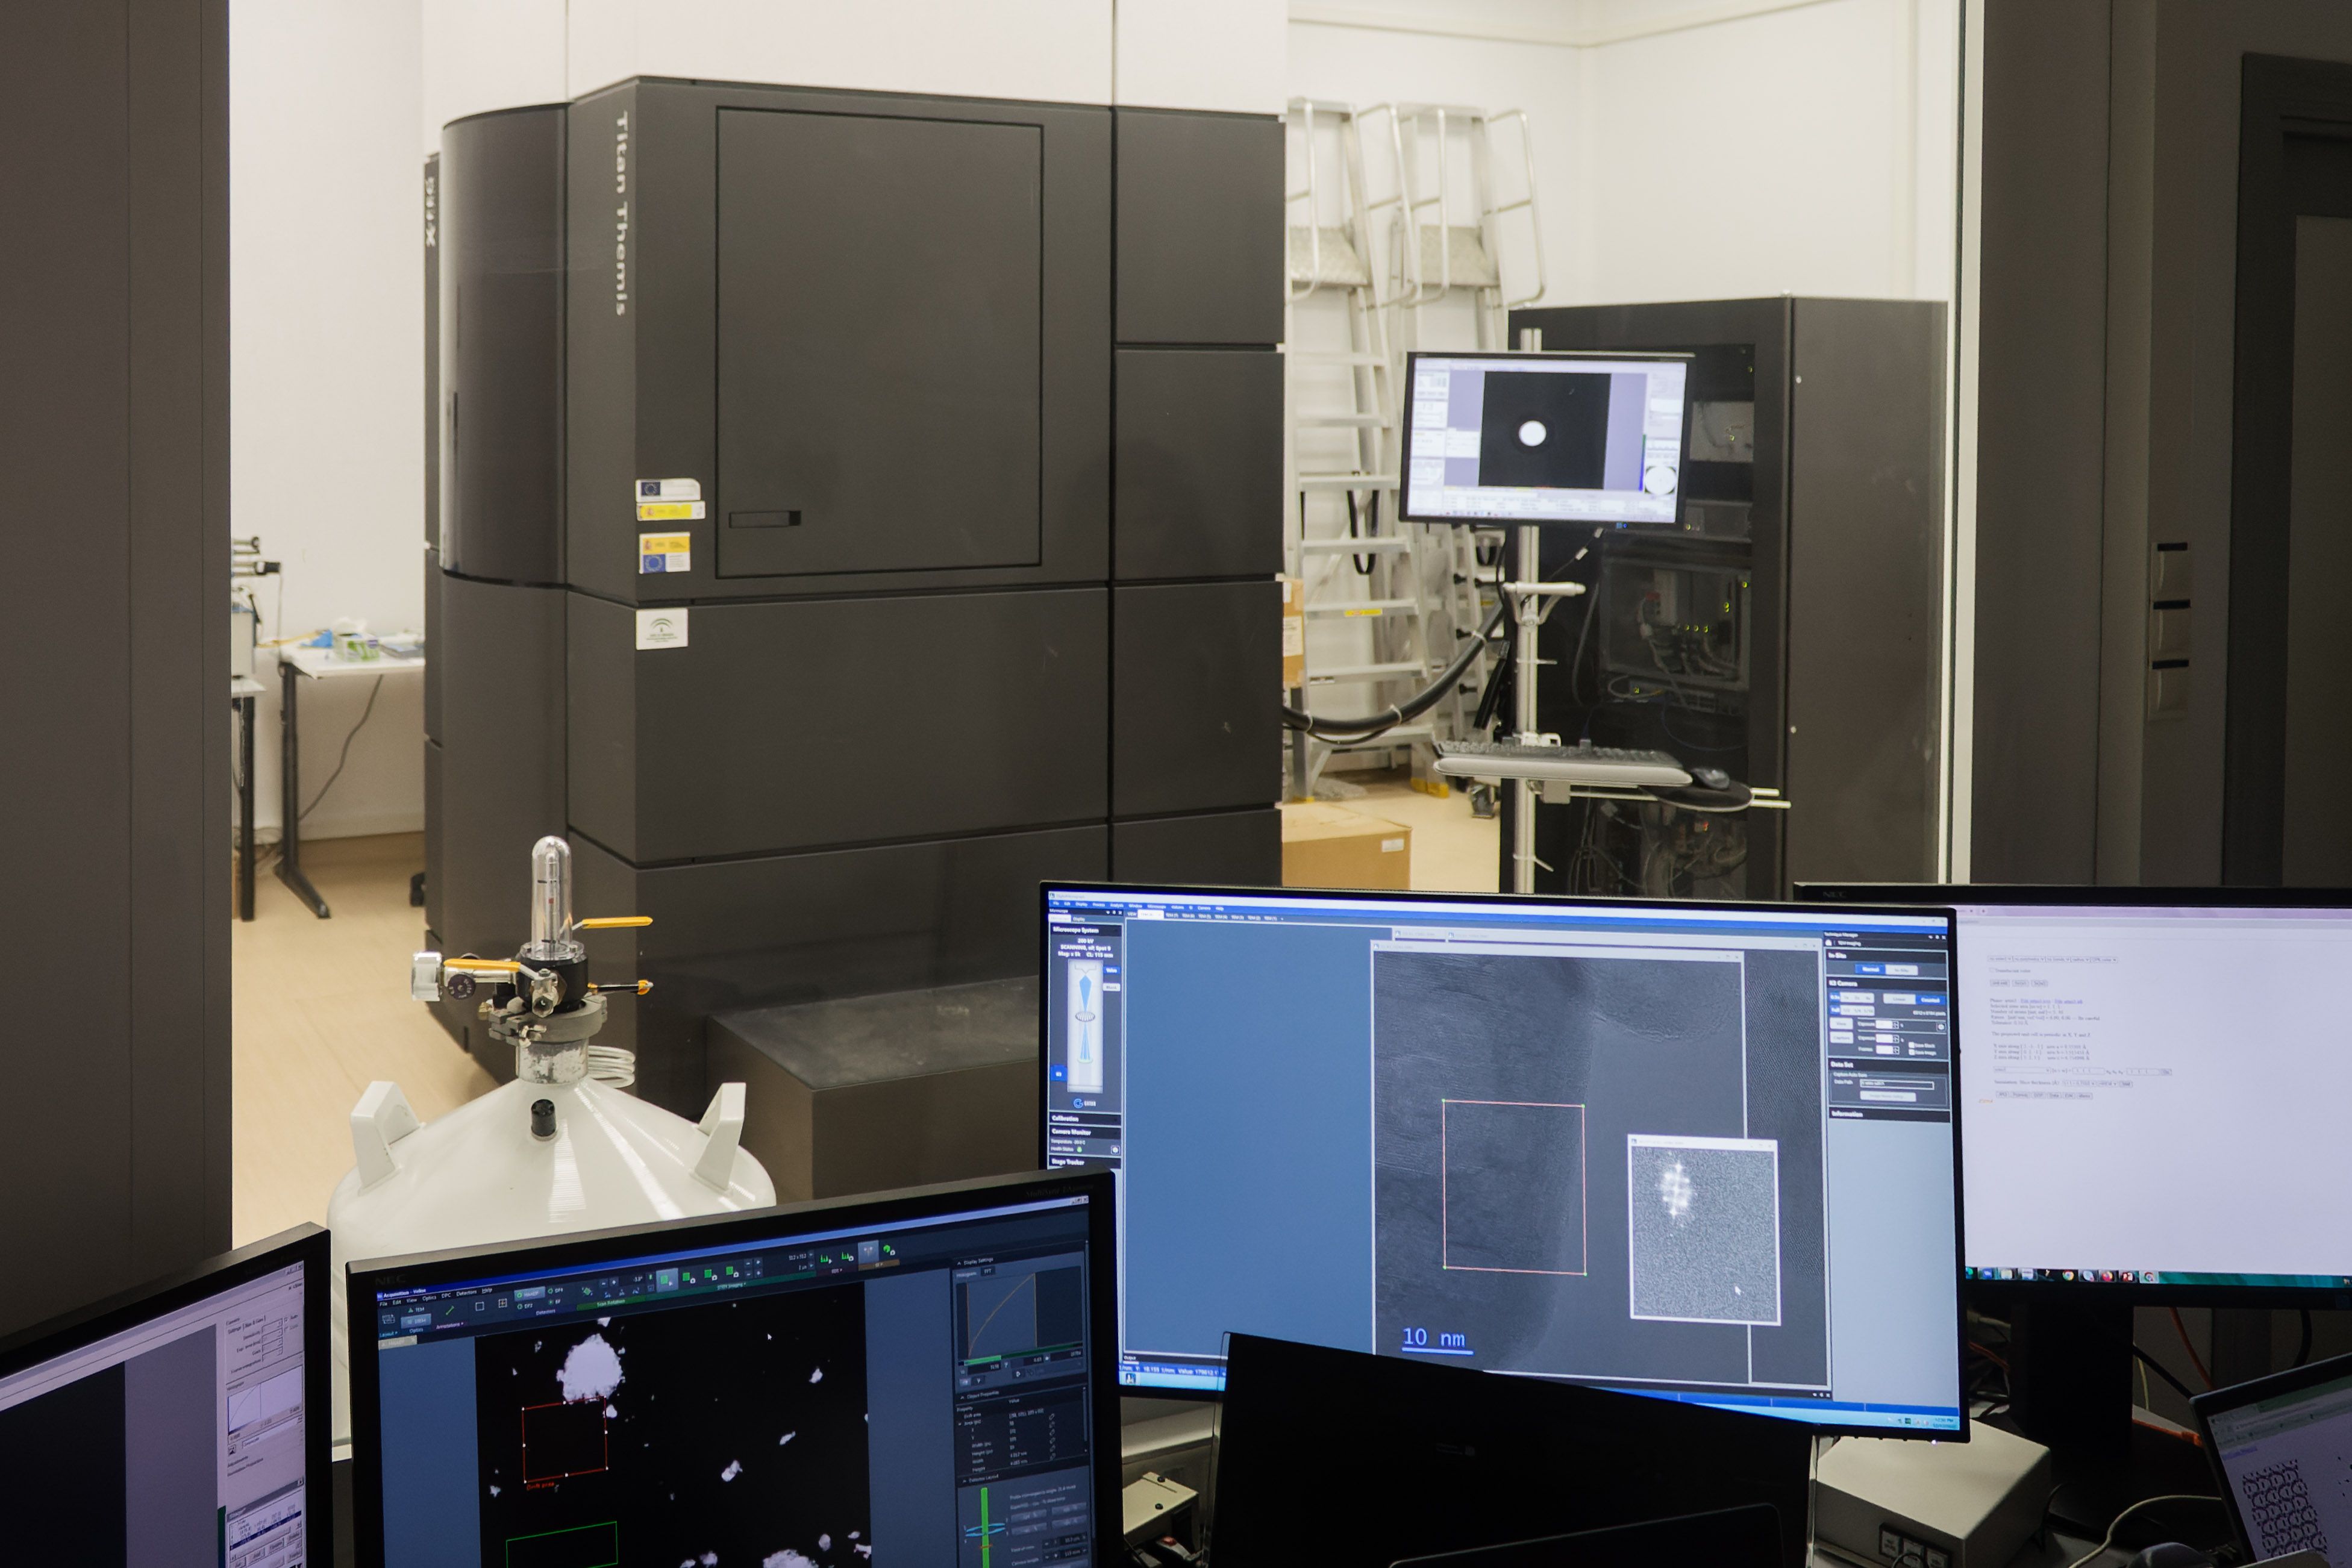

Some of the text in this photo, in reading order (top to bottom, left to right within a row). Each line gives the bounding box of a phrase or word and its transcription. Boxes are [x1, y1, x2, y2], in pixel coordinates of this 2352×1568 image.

[616, 110, 628, 316] Titan Themis
[375, 1274, 406, 1285] NEC
[1403, 1328, 1465, 1347] 10 nm
